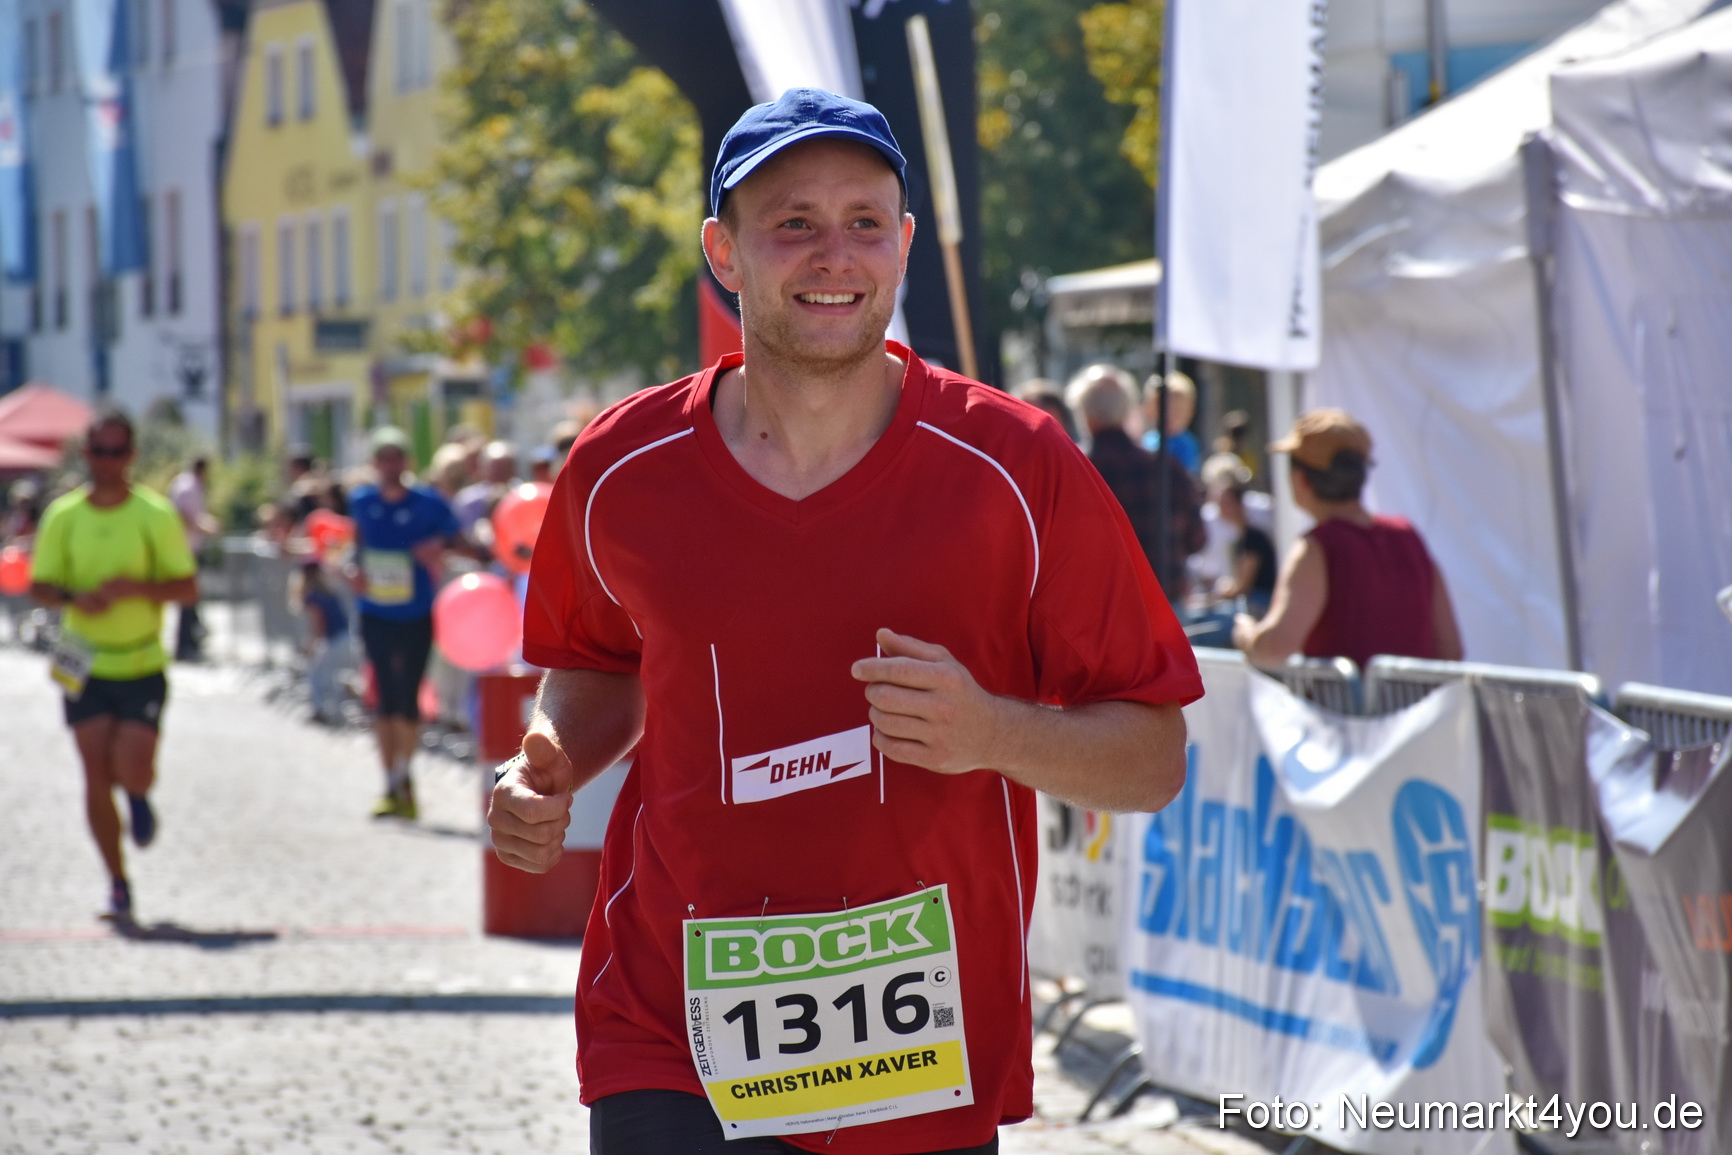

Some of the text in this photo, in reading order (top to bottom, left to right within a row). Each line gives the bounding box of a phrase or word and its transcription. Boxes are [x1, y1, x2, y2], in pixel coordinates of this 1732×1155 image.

[770, 750, 831, 785] DEHN
[708, 904, 928, 977] BOCK
[722, 971, 931, 1062] 1316
[730, 1049, 938, 1100] CHRISTIAN XAVER
